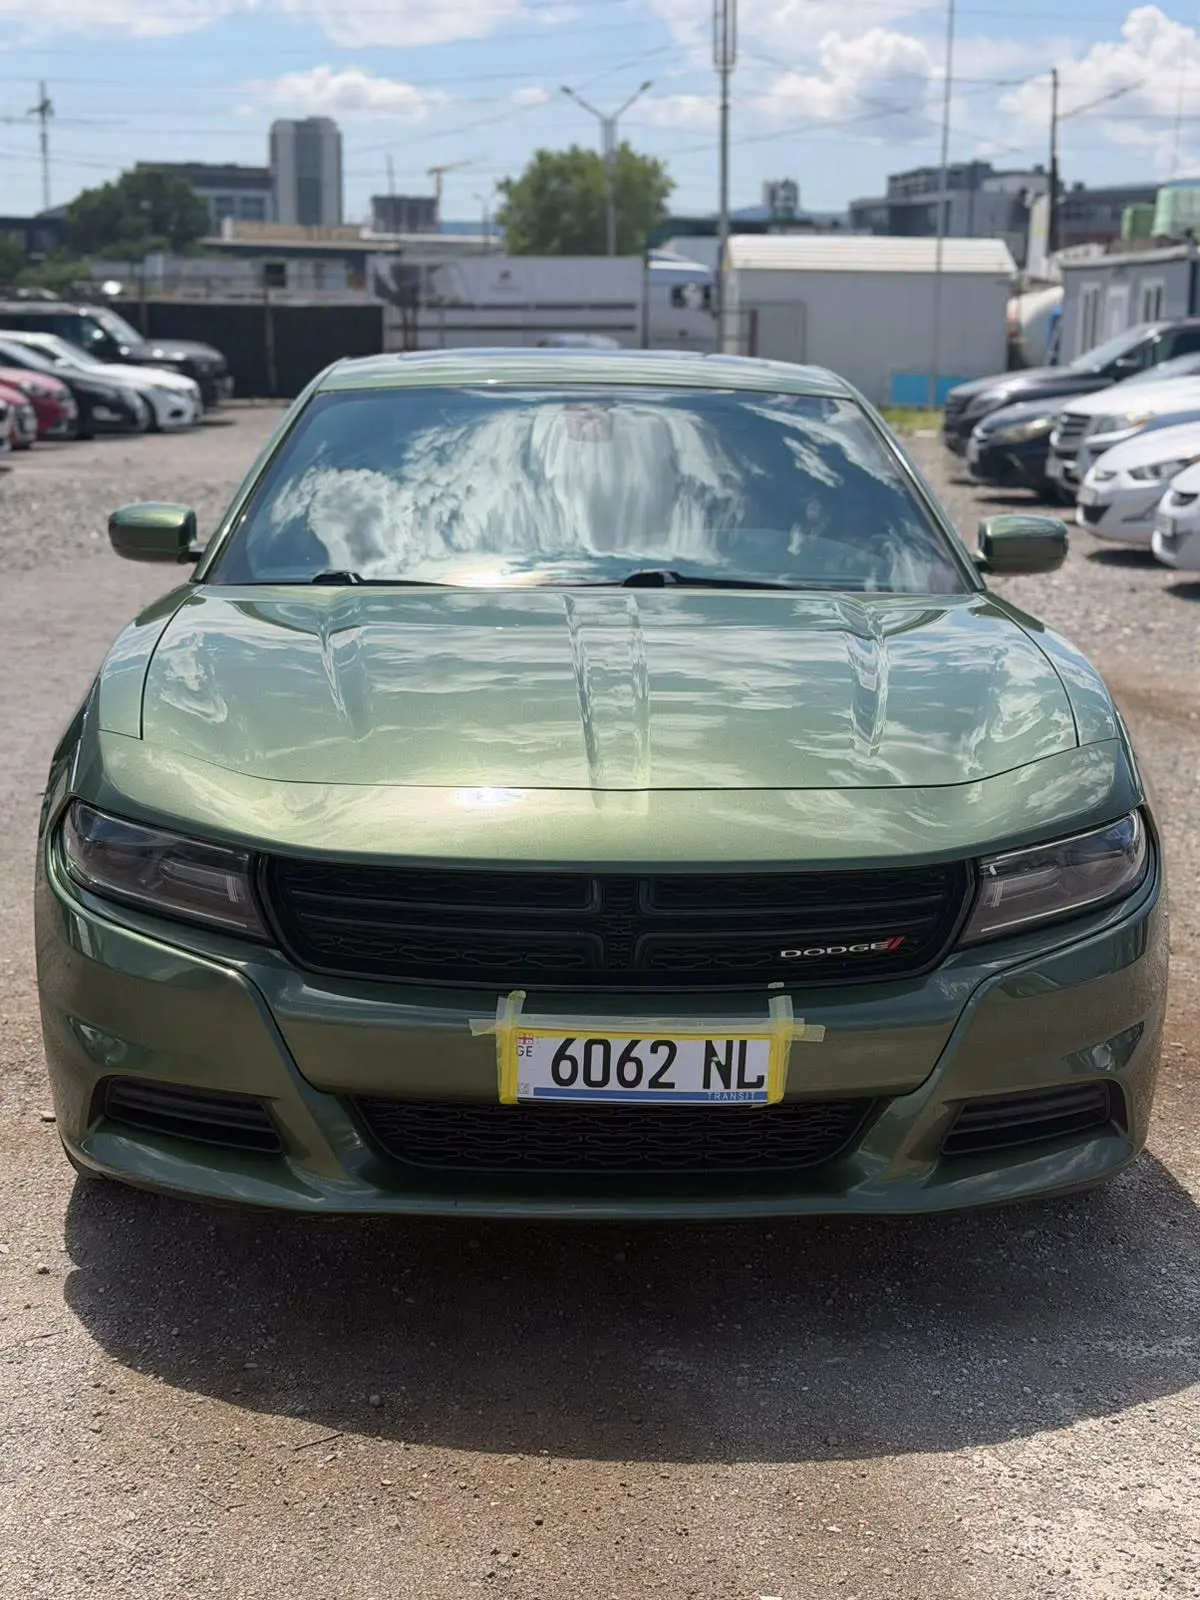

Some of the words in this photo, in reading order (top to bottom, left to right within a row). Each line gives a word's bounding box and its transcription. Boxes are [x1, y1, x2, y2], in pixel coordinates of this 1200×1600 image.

[780, 941, 889, 958] DODGE
[516, 1045, 533, 1058] GE
[551, 1037, 678, 1089] 6062
[702, 1039, 765, 1090] NL
[706, 1091, 756, 1101] TRANSIT
